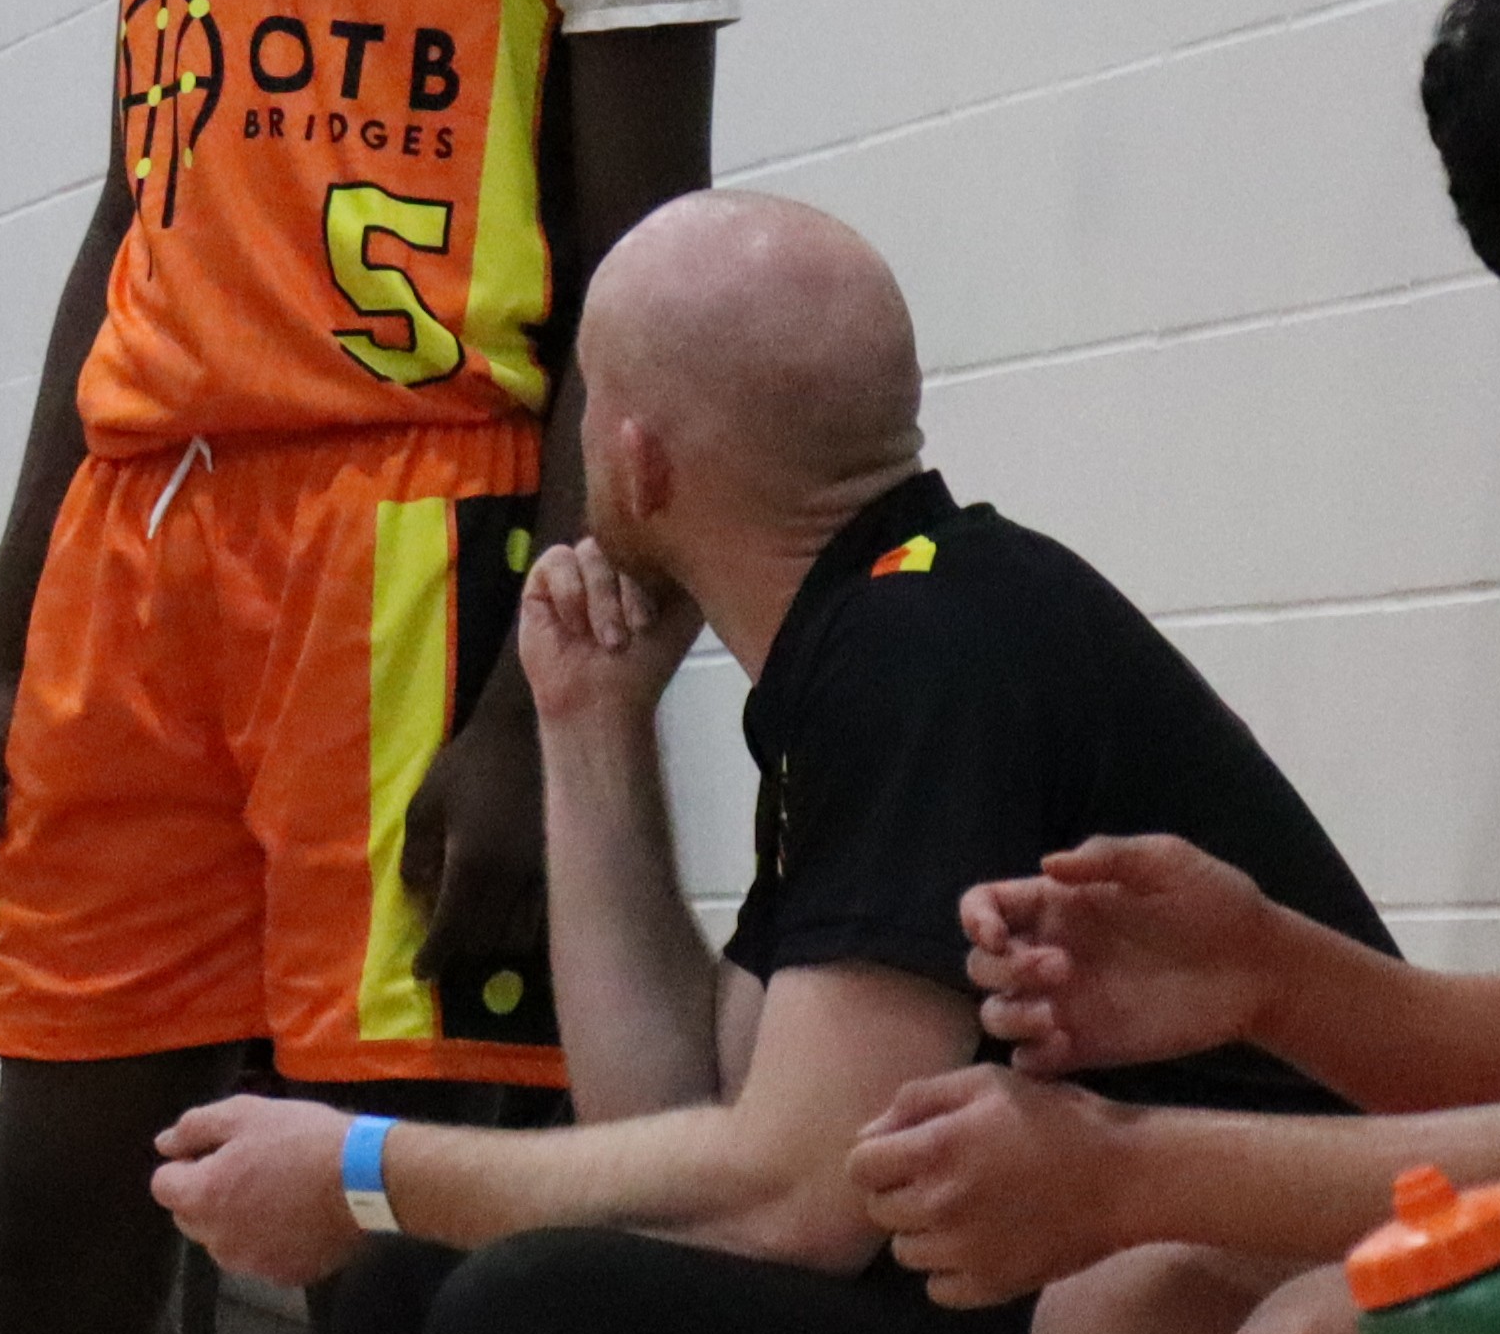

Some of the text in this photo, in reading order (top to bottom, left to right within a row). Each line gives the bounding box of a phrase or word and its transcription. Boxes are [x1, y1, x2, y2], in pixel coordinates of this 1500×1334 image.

[249, 14, 461, 113] OTB
[243, 109, 454, 160] BRIDGES
[322, 180, 467, 389] 5
